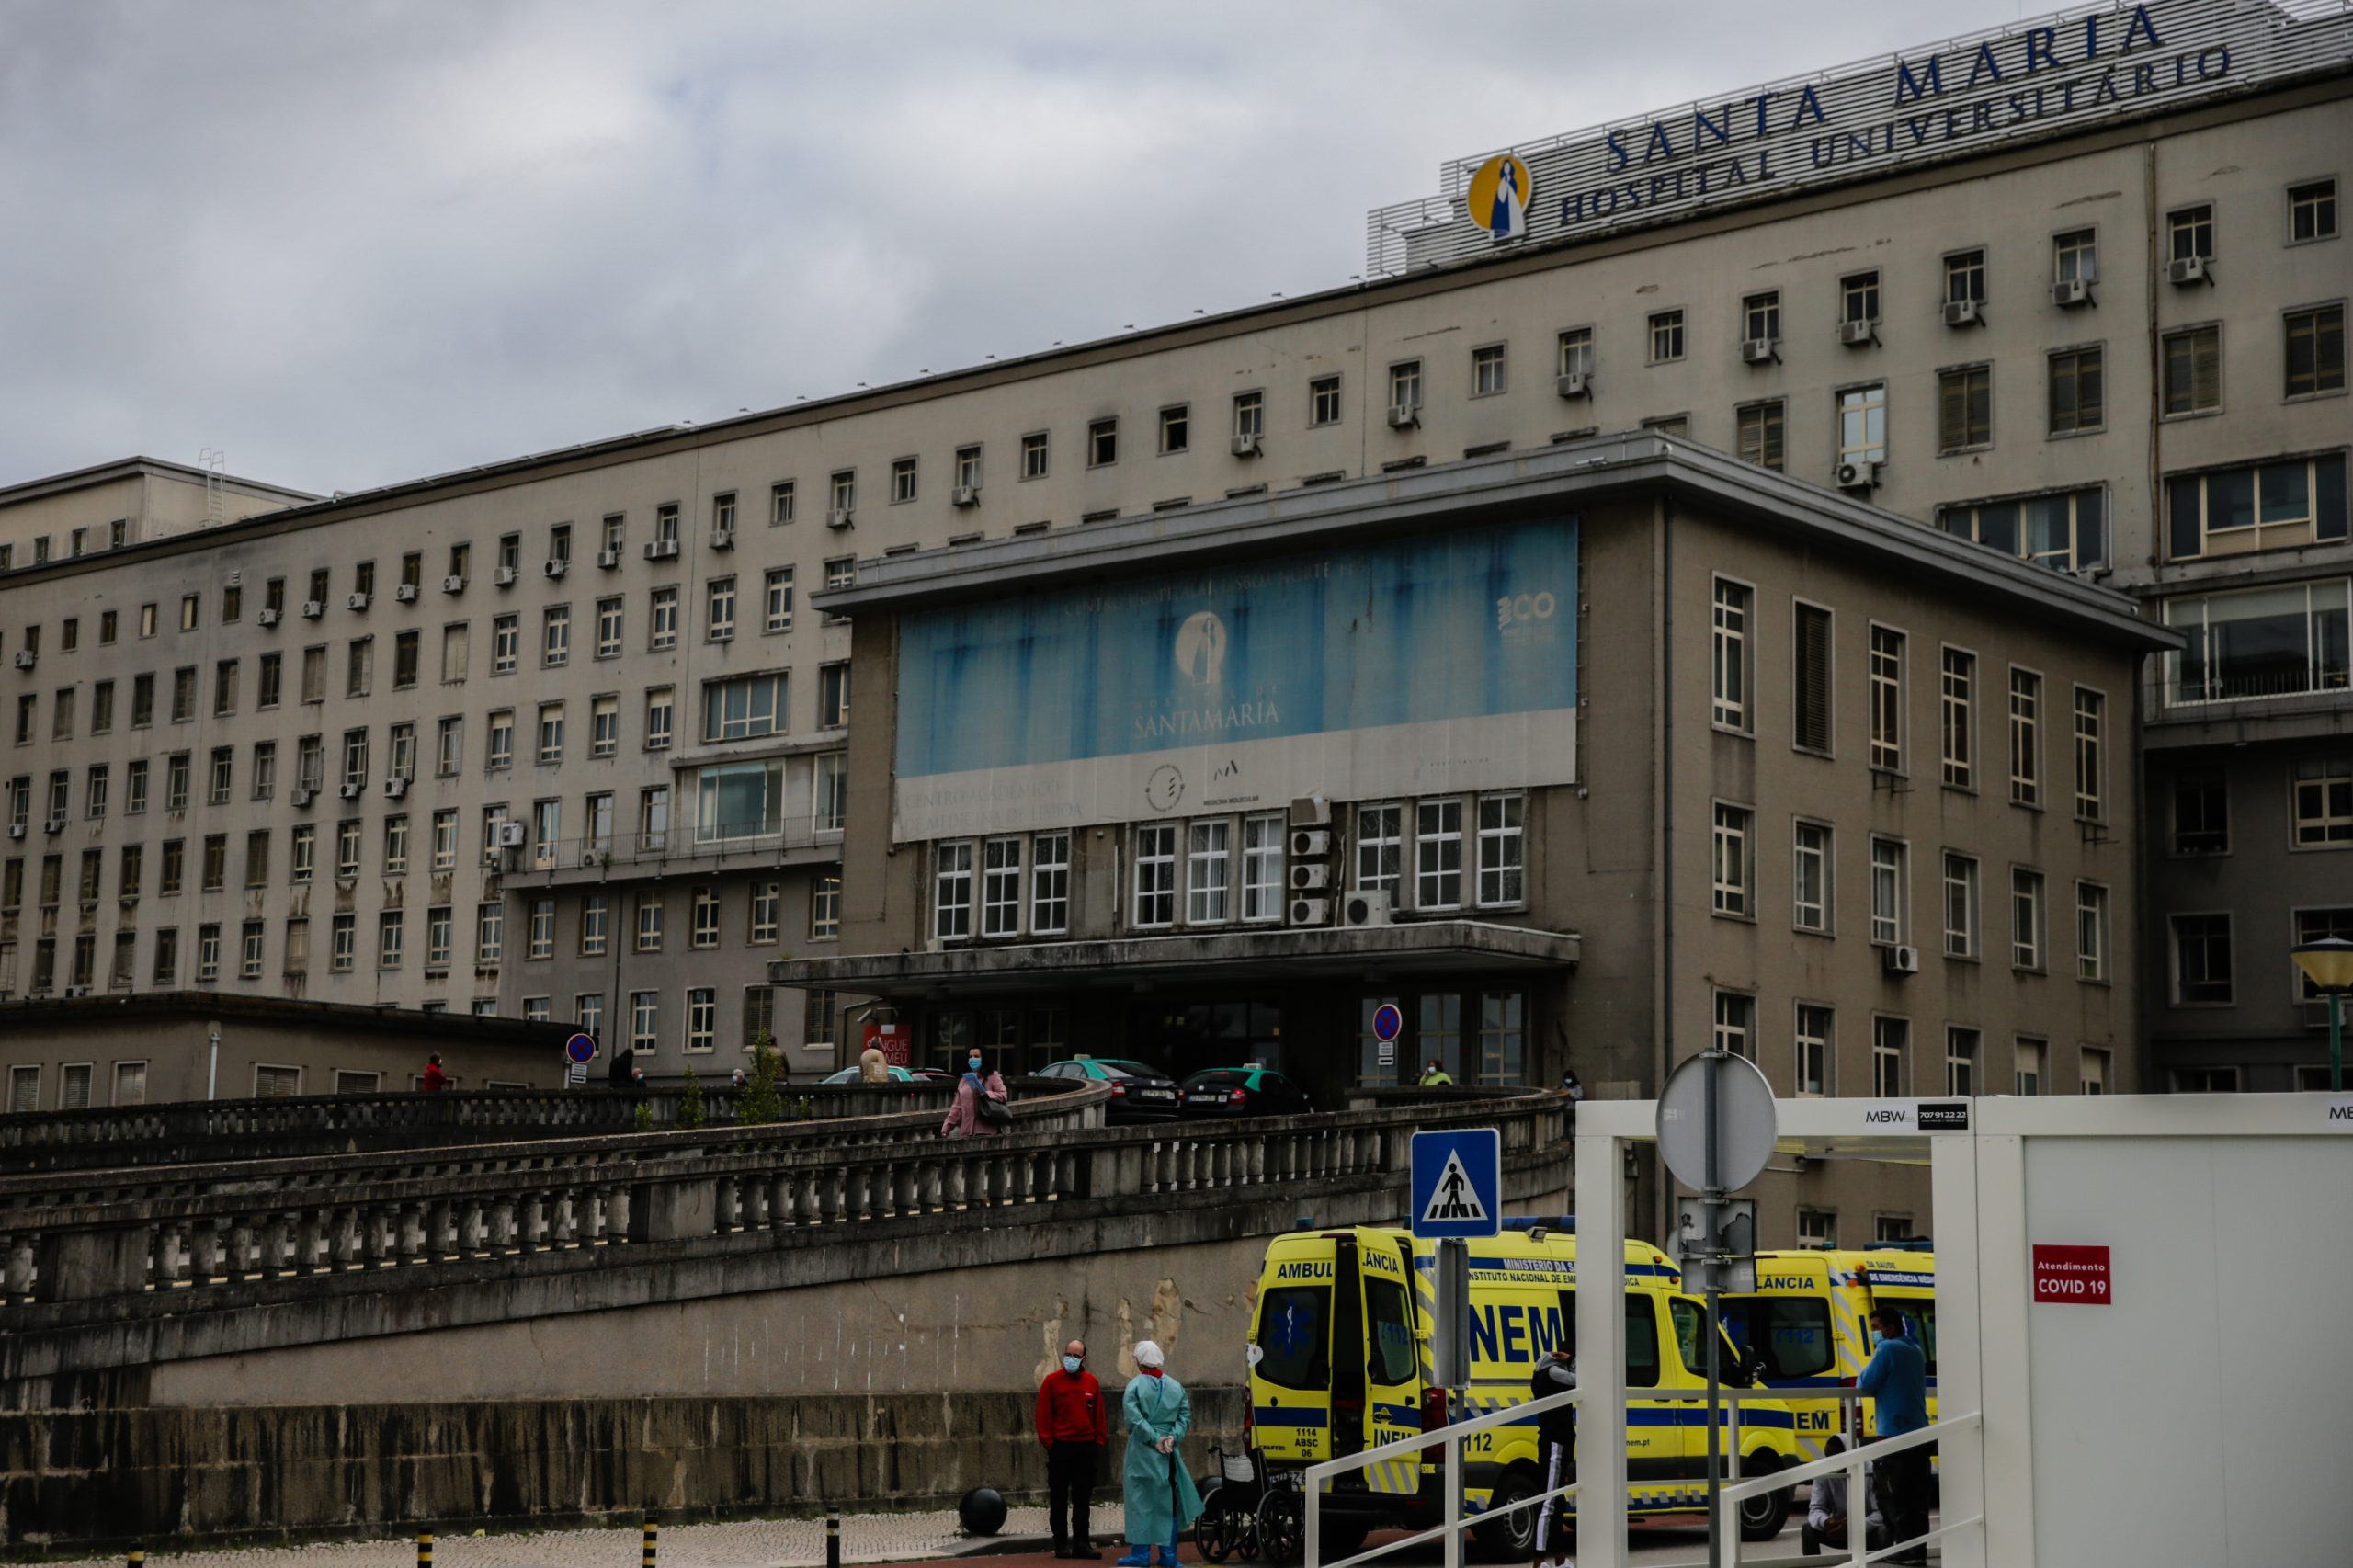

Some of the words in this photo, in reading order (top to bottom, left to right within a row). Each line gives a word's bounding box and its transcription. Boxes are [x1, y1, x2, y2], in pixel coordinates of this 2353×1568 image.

[1606, 84, 1827, 174] SANTA
[1893, 3, 2163, 107] MARIA
[1561, 149, 1776, 226] HOSPITAL
[1134, 700, 1280, 739] SANTAMARIA
[867, 1039, 907, 1051] SNGUE
[1866, 1110, 1905, 1123] MBW
[1555, 1261, 1567, 1272] DA
[2038, 1261, 2105, 1271] Atendimento
[1510, 1273, 1550, 1283] NACIONAL
[1552, 1274, 1562, 1284] DE
[2038, 1278, 2085, 1294] COVID
[2089, 1280, 2107, 1294] 19
[1296, 1428, 1317, 1437] 1114
[1294, 1438, 1318, 1447] ABSC
[1464, 1432, 1492, 1452] 112
